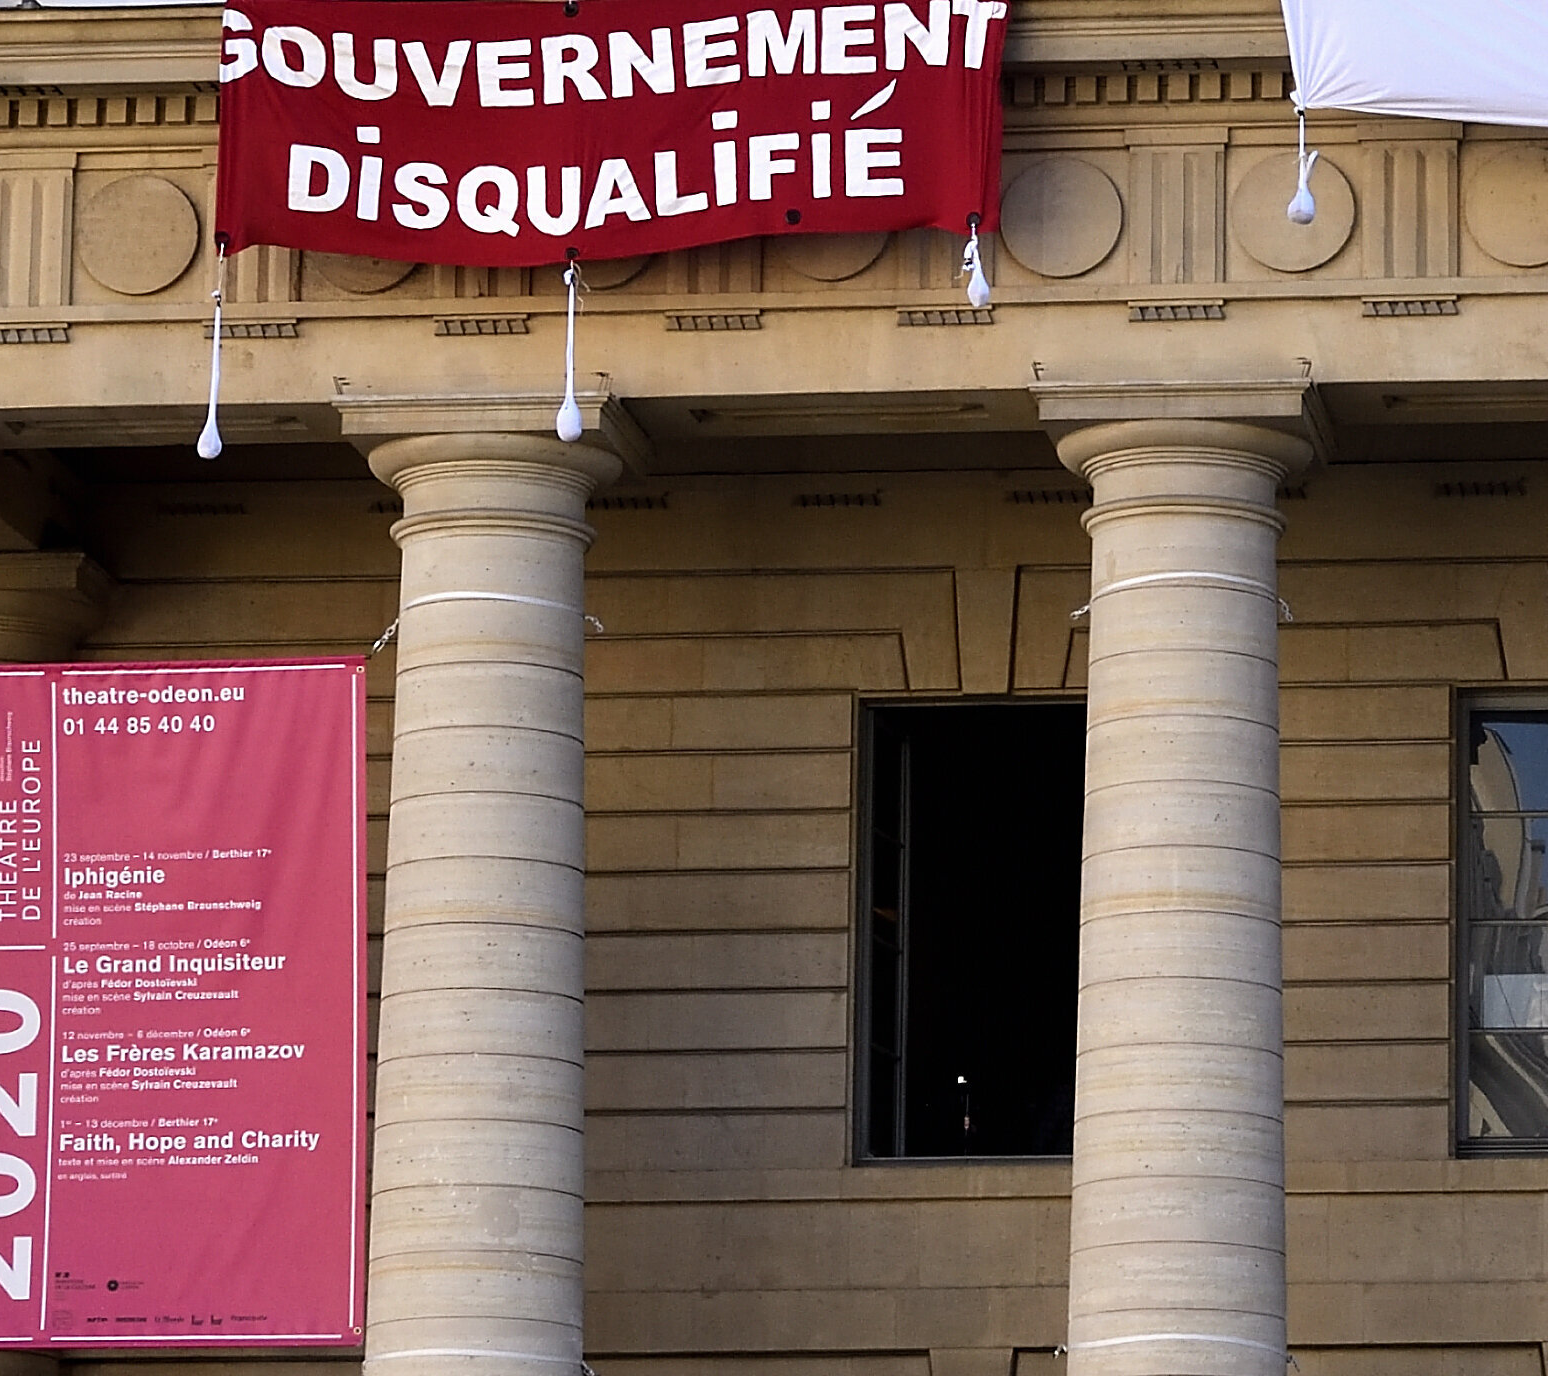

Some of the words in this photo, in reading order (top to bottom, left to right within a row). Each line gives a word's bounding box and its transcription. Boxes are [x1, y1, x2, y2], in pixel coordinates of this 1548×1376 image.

[63, 684, 245, 706] theatre-odeon.eu
[63, 718, 85, 736] 01
[94, 717, 118, 735] 44
[126, 717, 151, 734] 85
[157, 716, 183, 734] 40
[190, 716, 215, 733] 40
[22, 740, 41, 872] L'EUROPE
[64, 866, 165, 888] Iphigénie
[22, 887, 41, 920] DE
[106, 890, 142, 899] Racine
[64, 957, 88, 974] Le
[96, 956, 161, 973] Grand
[169, 953, 286, 975] Inquisiteur
[62, 1046, 99, 1063] Les
[107, 1044, 175, 1062] Frères
[183, 1043, 305, 1061] Karamazov
[60, 1134, 121, 1153] Faith,
[129, 1132, 186, 1153] Hope
[194, 1131, 233, 1148] and
[241, 1130, 320, 1152] Charity
[168, 1154, 222, 1165] Alexander
[224, 1154, 258, 1164] Zeldin
